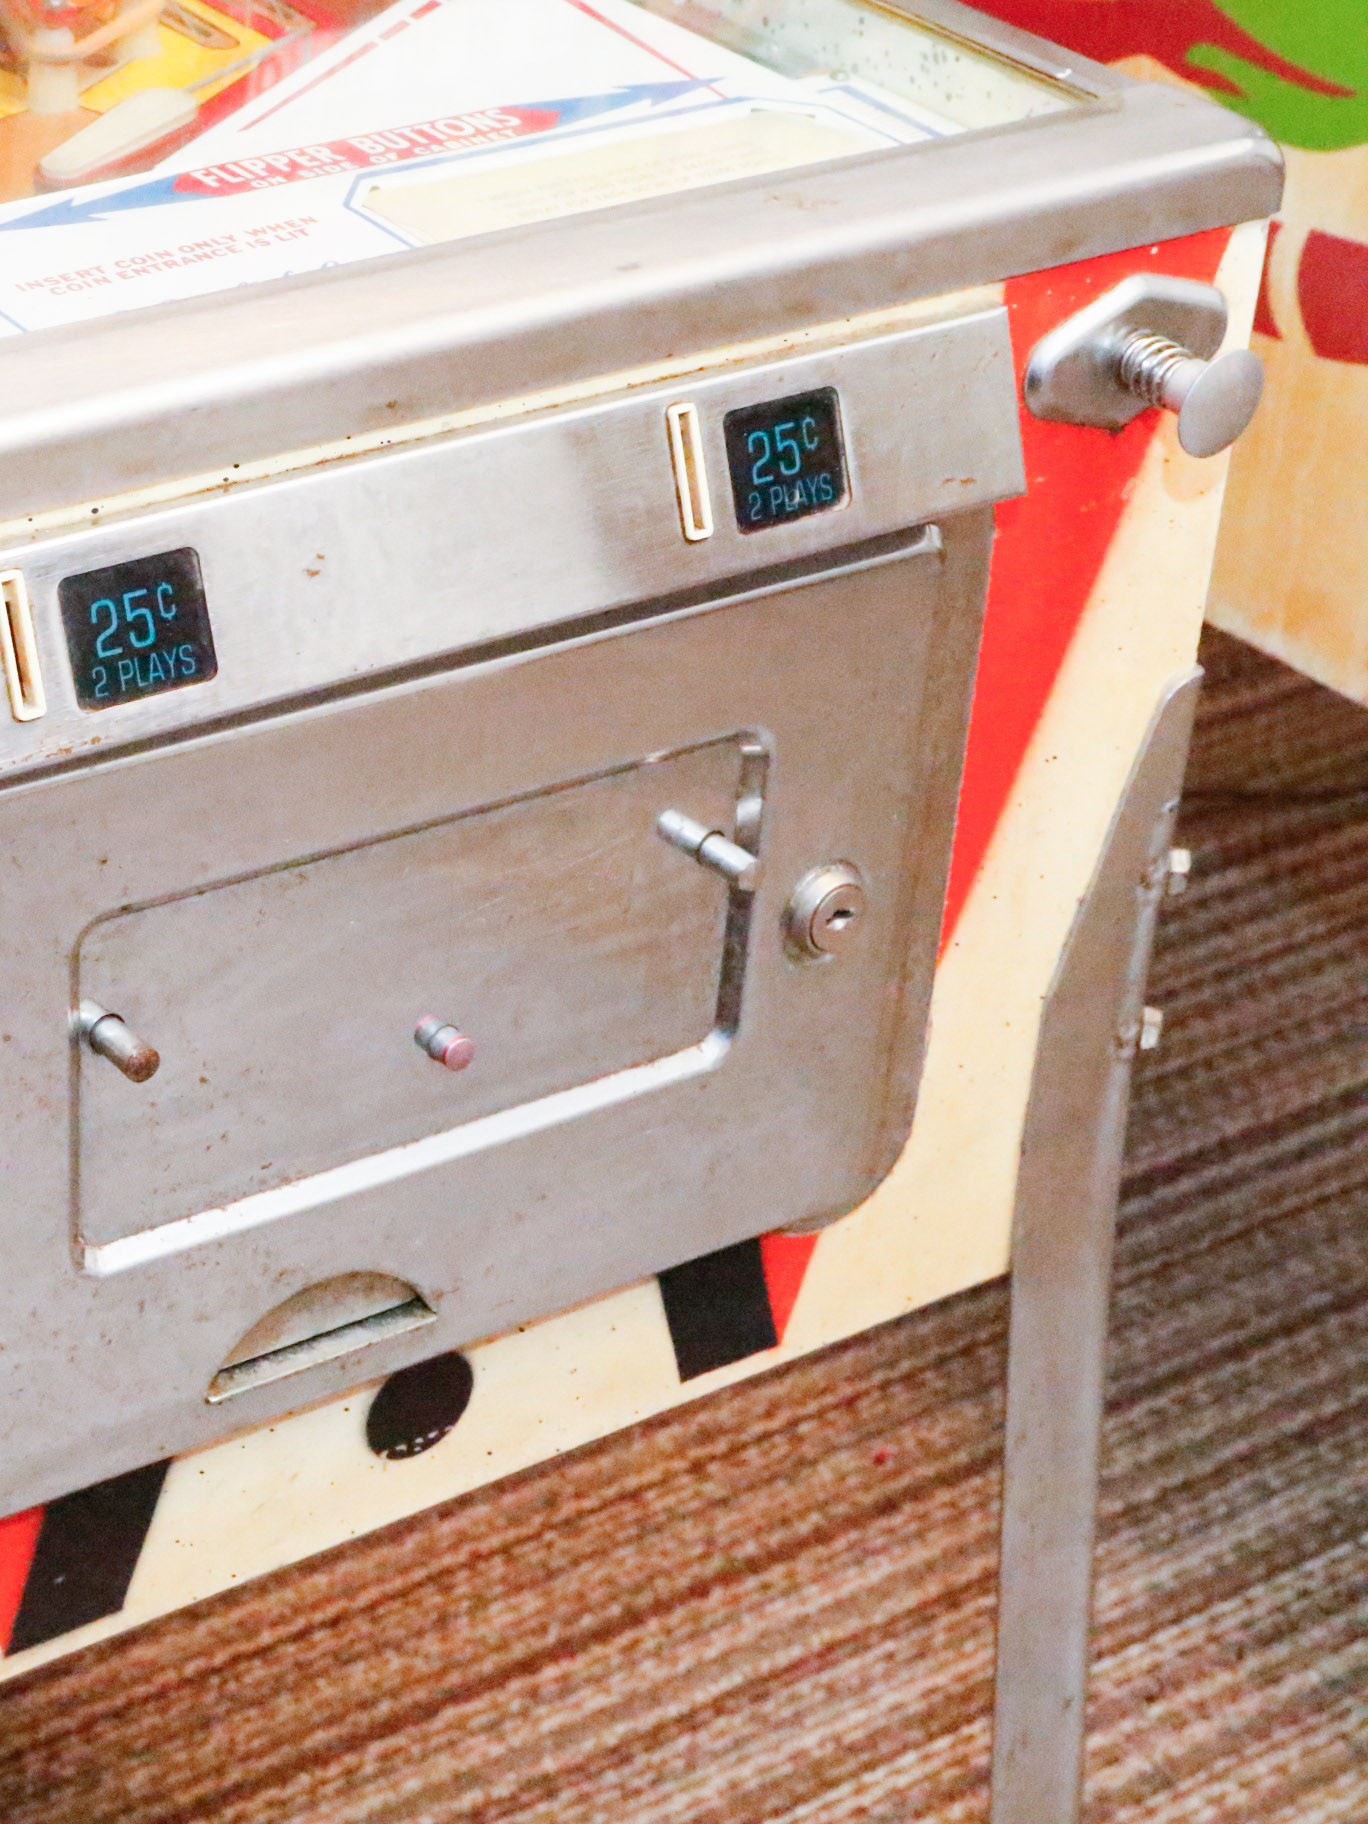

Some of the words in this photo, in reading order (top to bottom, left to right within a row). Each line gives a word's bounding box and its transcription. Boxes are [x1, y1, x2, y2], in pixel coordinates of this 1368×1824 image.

[190, 146, 347, 187] FLIPPER
[347, 108, 521, 155] BUTTONS
[249, 175, 289, 188] ON
[297, 161, 359, 178] SIDE
[369, 152, 399, 164] OF
[413, 130, 518, 155] CABINET
[14, 265, 107, 292] INSERT
[114, 249, 174, 270] COIN
[177, 233, 237, 254] ONLY
[243, 215, 319, 237] WHEN
[49, 276, 112, 296] COIN
[116, 245, 244, 280] ENTRANCE
[246, 237, 272, 250] IS
[274, 228, 312, 243] LIT
[748, 493, 762, 520] 2
[770, 472, 833, 515] PLAYS
[90, 582, 177, 658] 25¢
[91, 666, 109, 698] 2
[118, 644, 197, 692] PLAYS
